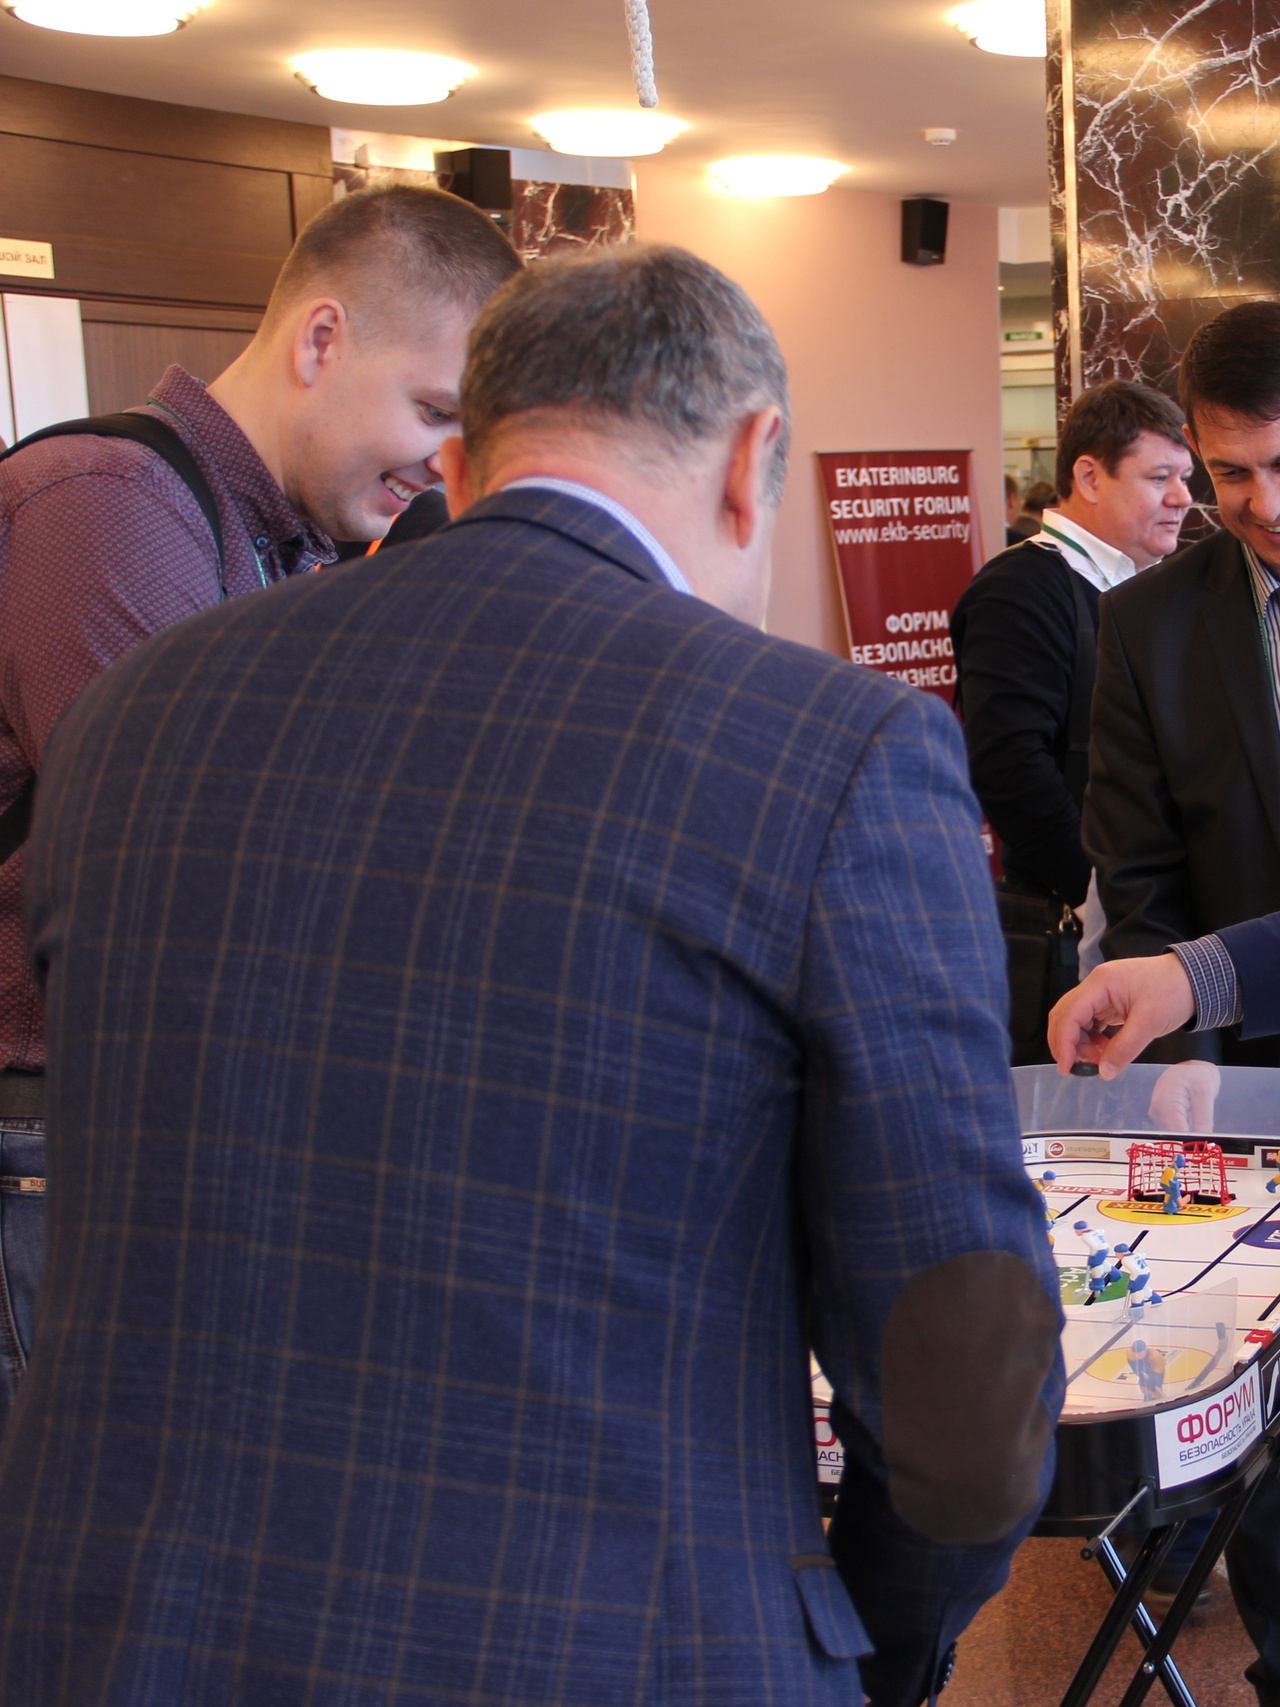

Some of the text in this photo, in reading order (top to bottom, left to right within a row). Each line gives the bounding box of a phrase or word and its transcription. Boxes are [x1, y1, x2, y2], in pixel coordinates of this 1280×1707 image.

[835, 465, 959, 487] EKATERINBURG
[830, 496, 970, 519] SECURITY FORUM
[835, 519, 970, 544] www.ekb-security
[886, 610, 949, 634] ФОРУМ
[1177, 1375, 1255, 1443] ФОРУМ
[1179, 1424, 1241, 1462] БЕЗОПАСНОСТЬ
